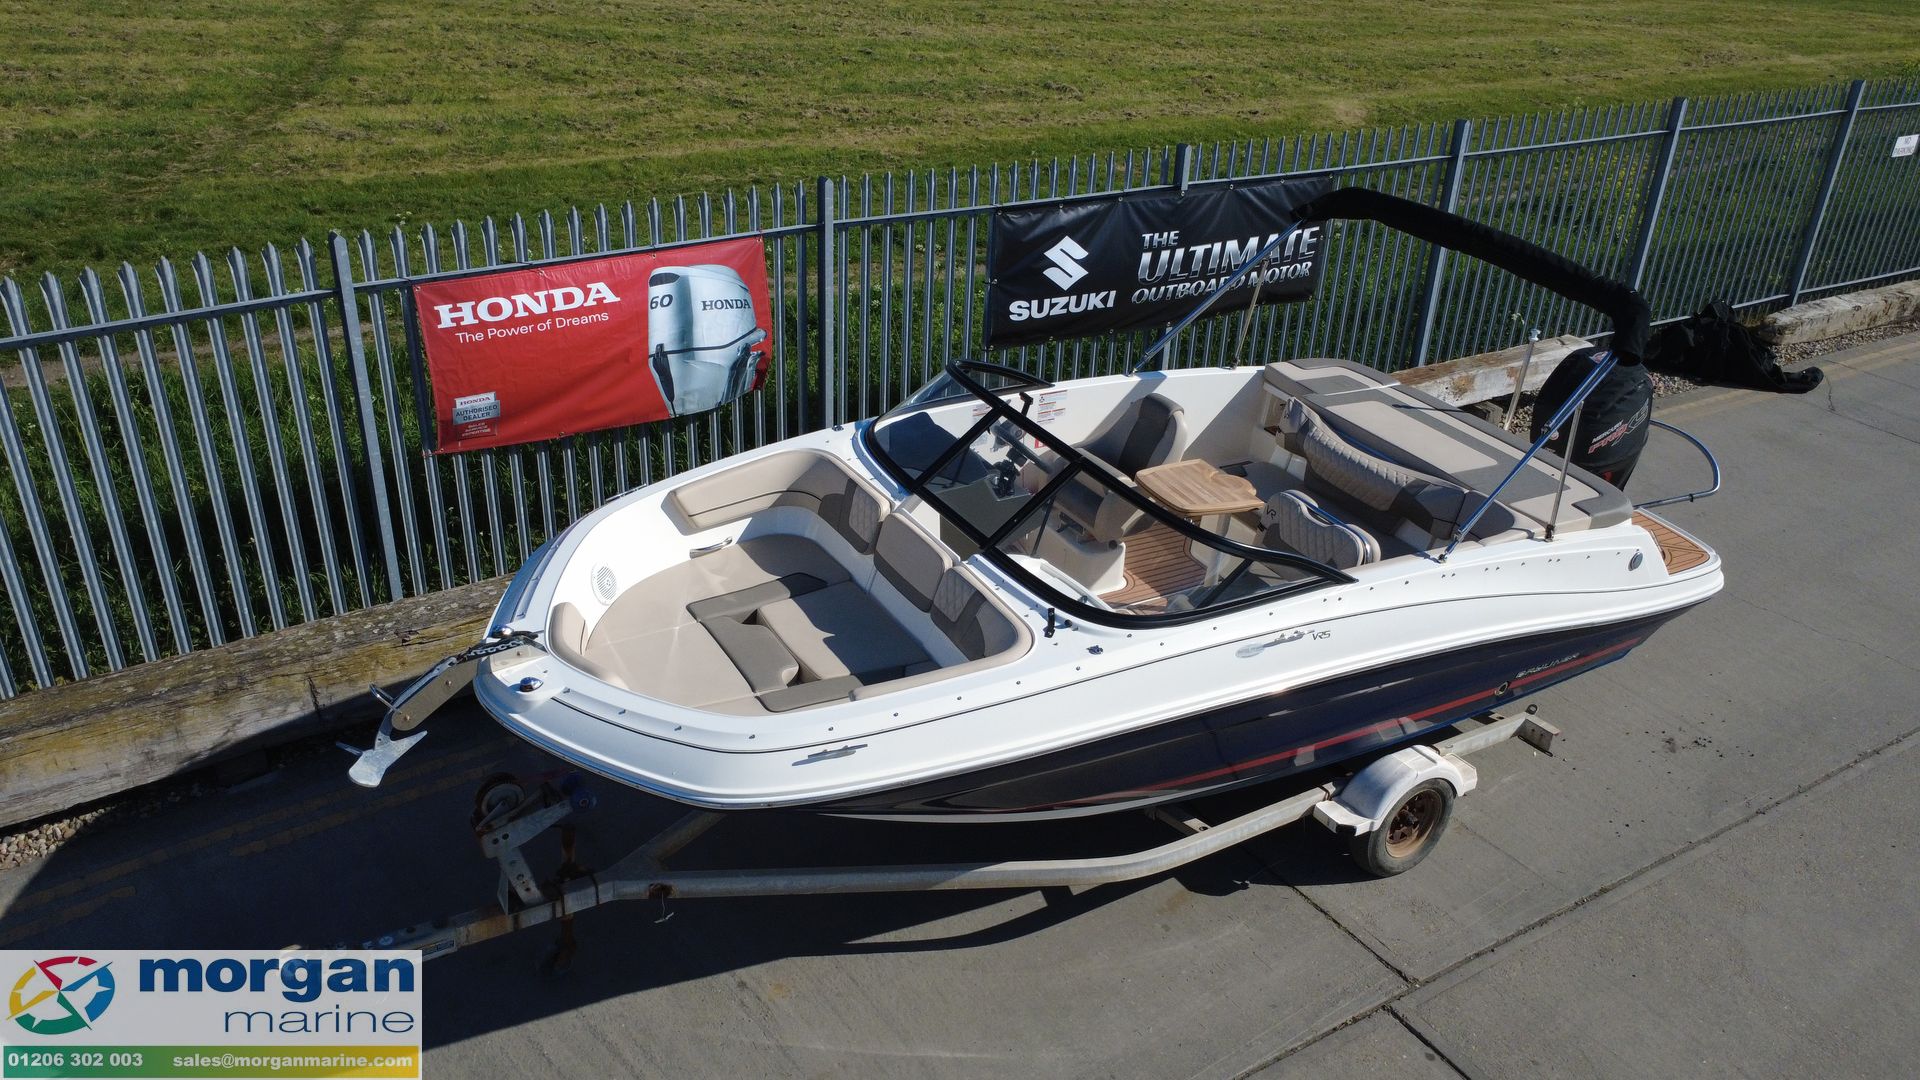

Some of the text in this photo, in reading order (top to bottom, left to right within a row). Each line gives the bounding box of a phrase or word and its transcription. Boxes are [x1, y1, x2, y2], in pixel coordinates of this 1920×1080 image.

[1142, 230, 1180, 250] THE
[1137, 226, 1320, 286] ULTIMATE
[433, 281, 621, 329] HONDA
[650, 293, 674, 310] 60
[701, 298, 752, 312] HONDA
[1009, 290, 1117, 322] SUZUKI
[455, 311, 609, 344] The Power of Dreams
[460, 396, 491, 406] HONDA
[455, 404, 498, 417] AUTHORISED
[463, 411, 491, 421] DEALER
